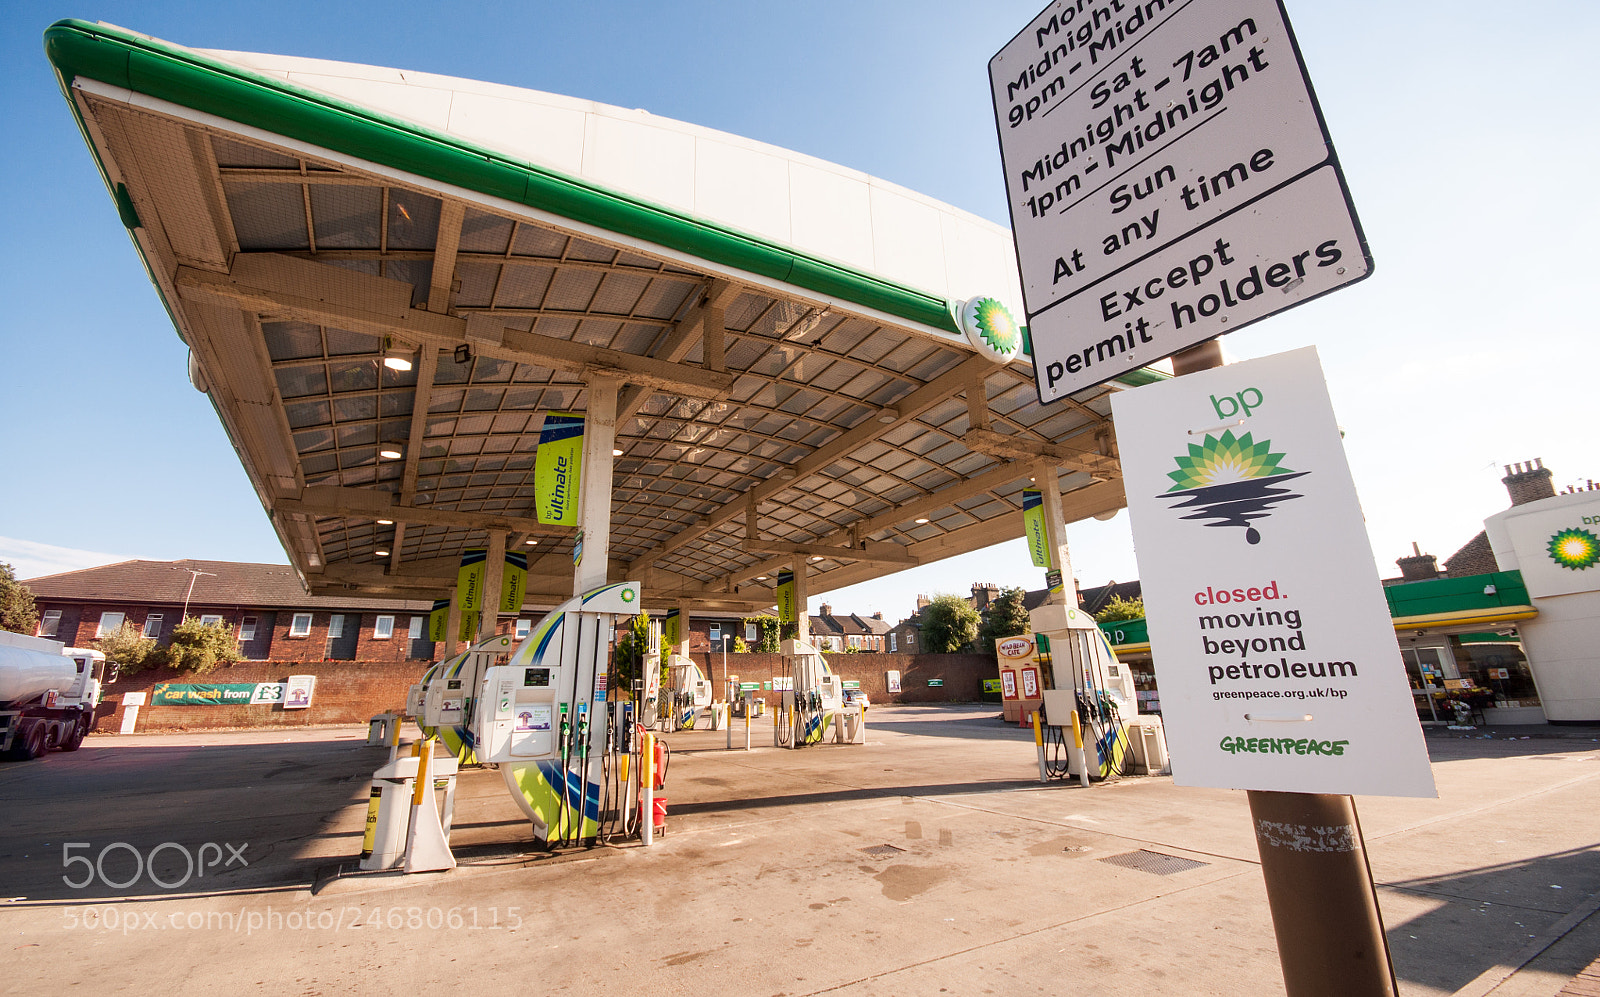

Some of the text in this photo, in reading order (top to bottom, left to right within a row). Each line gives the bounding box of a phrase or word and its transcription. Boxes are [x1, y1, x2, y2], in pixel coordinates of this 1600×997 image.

[1007, 0, 1125, 102] Midnight
[1008, 76, 1065, 128] 9pm
[1089, 0, 1177, 65] Midn
[1090, 56, 1147, 109] Sat
[1021, 88, 1150, 192] Midnight
[1173, 17, 1257, 83] 7am
[1027, 176, 1081, 218] 1pm
[1107, 46, 1269, 168] Midnight
[1110, 164, 1176, 214] Sun
[1052, 148, 1275, 285] At any time
[1100, 237, 1235, 322] Except
[1046, 239, 1342, 388] permit holders
[1209, 386, 1264, 420] bp
[550, 456, 568, 521] ultimate
[1581, 515, 1600, 526] bp
[1033, 519, 1044, 564] ultimate
[464, 572, 476, 609] ultimate
[507, 575, 517, 610] ultimate
[1193, 581, 1288, 607] closed.
[1102, 628, 1125, 645] bp
[1199, 607, 1301, 630] moving
[1203, 631, 1306, 658] beyond
[1208, 658, 1358, 685] petroleum
[165, 685, 283, 700] car wash from £3
[1212, 687, 1348, 701] greenpeace.org.uk/bp
[1219, 736, 1349, 757] GREENPEACE
